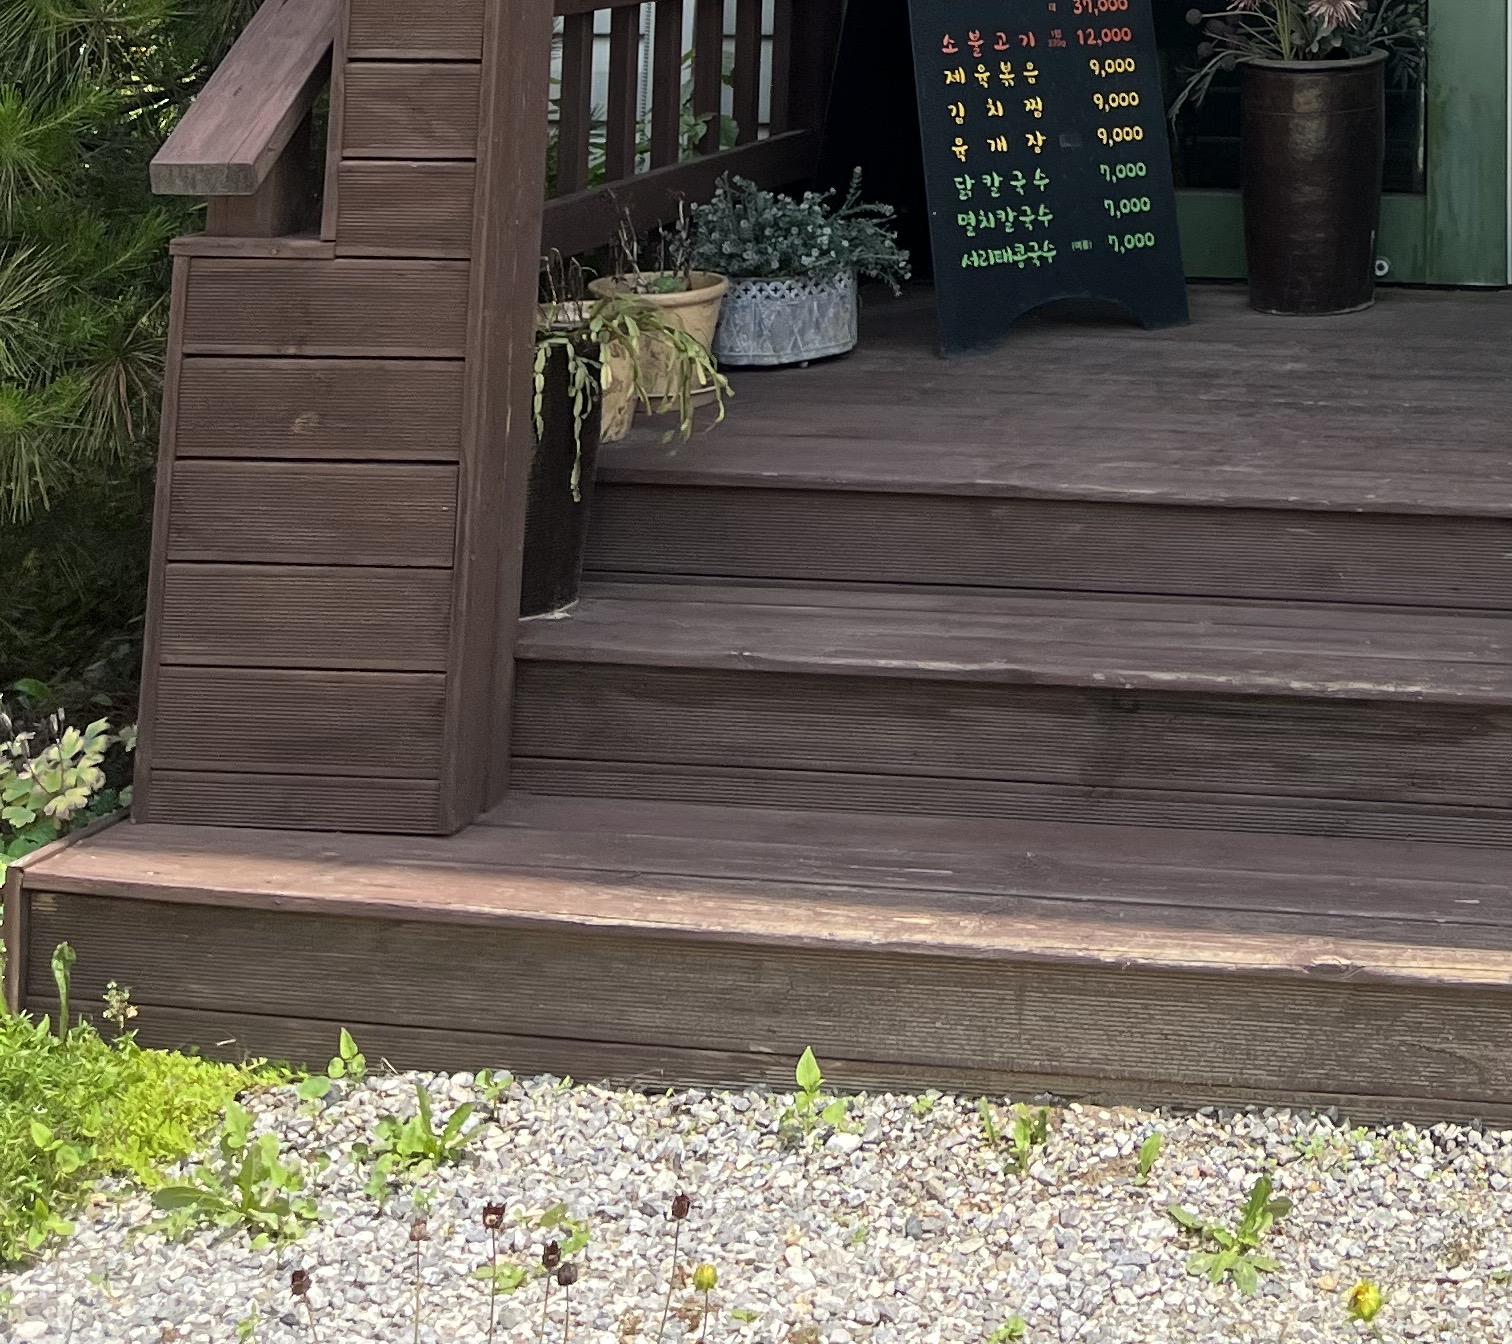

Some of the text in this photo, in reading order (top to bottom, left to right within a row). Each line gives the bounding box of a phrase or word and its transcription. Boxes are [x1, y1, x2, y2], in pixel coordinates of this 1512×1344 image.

[1076, 27, 1132, 48] 12,000
[1089, 57, 1136, 78] 9,000
[1092, 91, 1140, 113] 9,000
[1096, 126, 1144, 148] 9,000
[1099, 161, 1147, 184] 7,000
[957, 197, 1151, 237] 멸치칼국수 7,000
[961, 240, 1057, 269] 서리태콩국수
[1107, 232, 1155, 255] 7,000
